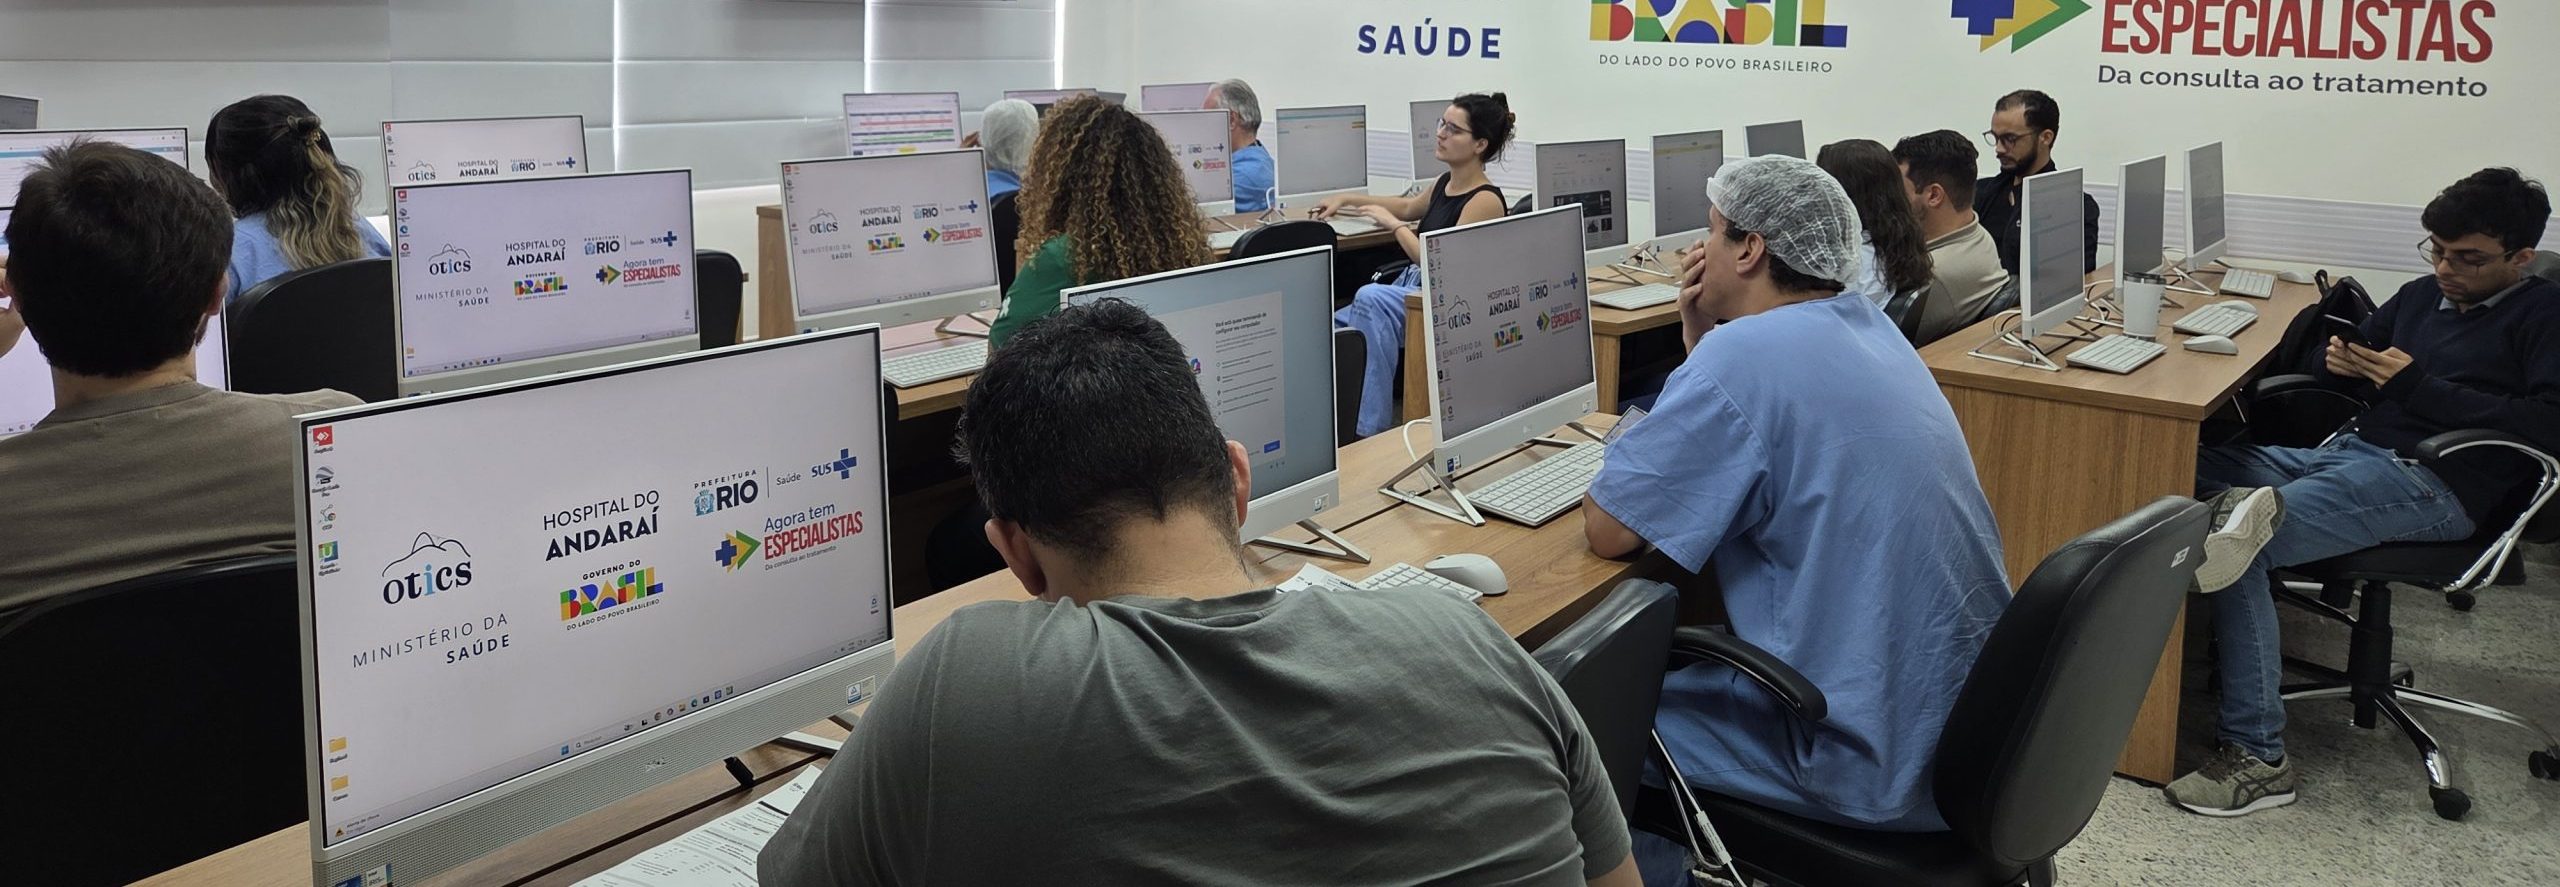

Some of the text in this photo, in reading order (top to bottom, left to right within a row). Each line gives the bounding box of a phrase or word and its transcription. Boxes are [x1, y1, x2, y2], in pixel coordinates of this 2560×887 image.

[1357, 18, 1501, 58] SAÚDE
[2100, 0, 2496, 63] ESPECIALISTAS
[1599, 54, 1833, 73] DO LADO DO POVO BRASILEIRO
[2098, 64, 2488, 97] Da consulta ao tratamento
[408, 170, 436, 182] otics
[459, 165, 499, 178] ANDARAÍ
[519, 162, 536, 172] RIO
[922, 207, 938, 218] RIO
[809, 222, 838, 234] otics
[505, 239, 566, 251] HOSPITAL DO
[596, 241, 620, 254] RIO
[507, 247, 566, 266] ANDARAÍ
[623, 258, 664, 269] Agora tem
[429, 259, 471, 275] otics
[623, 264, 681, 283] ESPECIALISTAS
[415, 288, 472, 301] MINISTÉRIO
[1535, 285, 1548, 299] RIO
[459, 297, 489, 307] SAÚDE
[1489, 294, 1520, 316] ANDARAÍ
[1448, 311, 1471, 329] otics
[694, 469, 757, 489] PREFEITURA
[776, 473, 802, 486] Saúde
[811, 463, 832, 478] SUS
[716, 479, 759, 511] RIO
[543, 490, 660, 530] HOSPITAL DO
[764, 503, 836, 533] Agora tem
[545, 505, 660, 561] ANDARAÍ
[764, 511, 863, 561] ESPECIALISTAS
[582, 559, 641, 580] GOVERNO DO
[382, 561, 472, 605] otics
[560, 566, 664, 621] BRASIL
[566, 599, 660, 631] DO LADO DO POVO BRASILEIRO
[353, 613, 508, 668] MINISTÉRIO DA
[446, 634, 510, 664] SAÚDE
